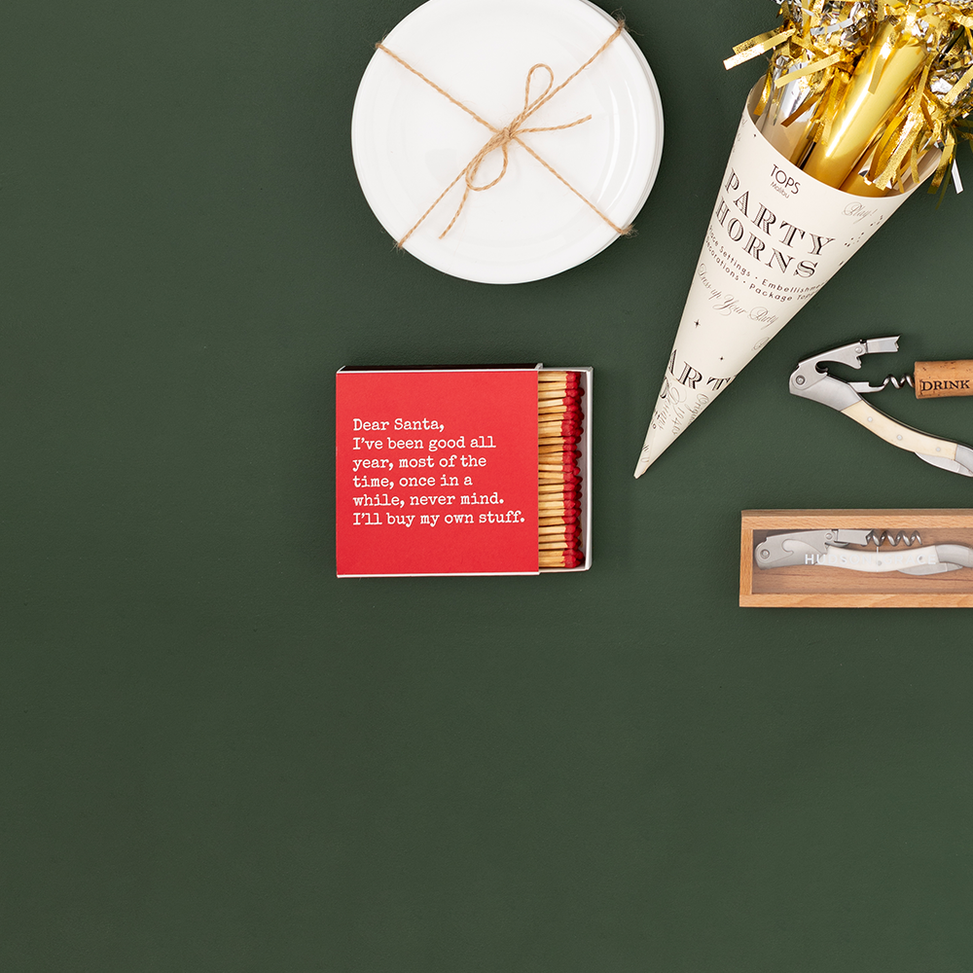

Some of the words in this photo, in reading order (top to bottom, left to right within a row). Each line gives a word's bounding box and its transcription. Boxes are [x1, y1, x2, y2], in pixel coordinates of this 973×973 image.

[770, 163, 801, 195] TOPS
[725, 167, 836, 257] PARTY
[715, 196, 819, 278] HORNS
[719, 245, 751, 278] Settings
[921, 380, 970, 392] DRINK
[353, 418, 390, 431] Dear
[394, 417, 445, 433] Santa,
[352, 437, 383, 450] I’ve
[387, 437, 424, 450] been
[428, 436, 466, 452] good
[470, 436, 497, 448] all
[352, 458, 394, 472] year,
[398, 456, 435, 468] most
[439, 454, 458, 468] of
[460, 454, 487, 468] the
[352, 475, 395, 490] time,
[399, 476, 436, 487] once
[440, 474, 460, 487] in
[463, 476, 473, 486] a
[352, 493, 405, 509] while,
[409, 495, 456, 506] never
[460, 491, 505, 505] mind.
[352, 512, 383, 526] I’ll
[386, 512, 416, 528] buy
[420, 513, 440, 527] my
[444, 513, 474, 524] own
[478, 510, 526, 524] stuff.
[804, 553, 870, 566] HUDSON
[881, 553, 936, 566] GRACE
